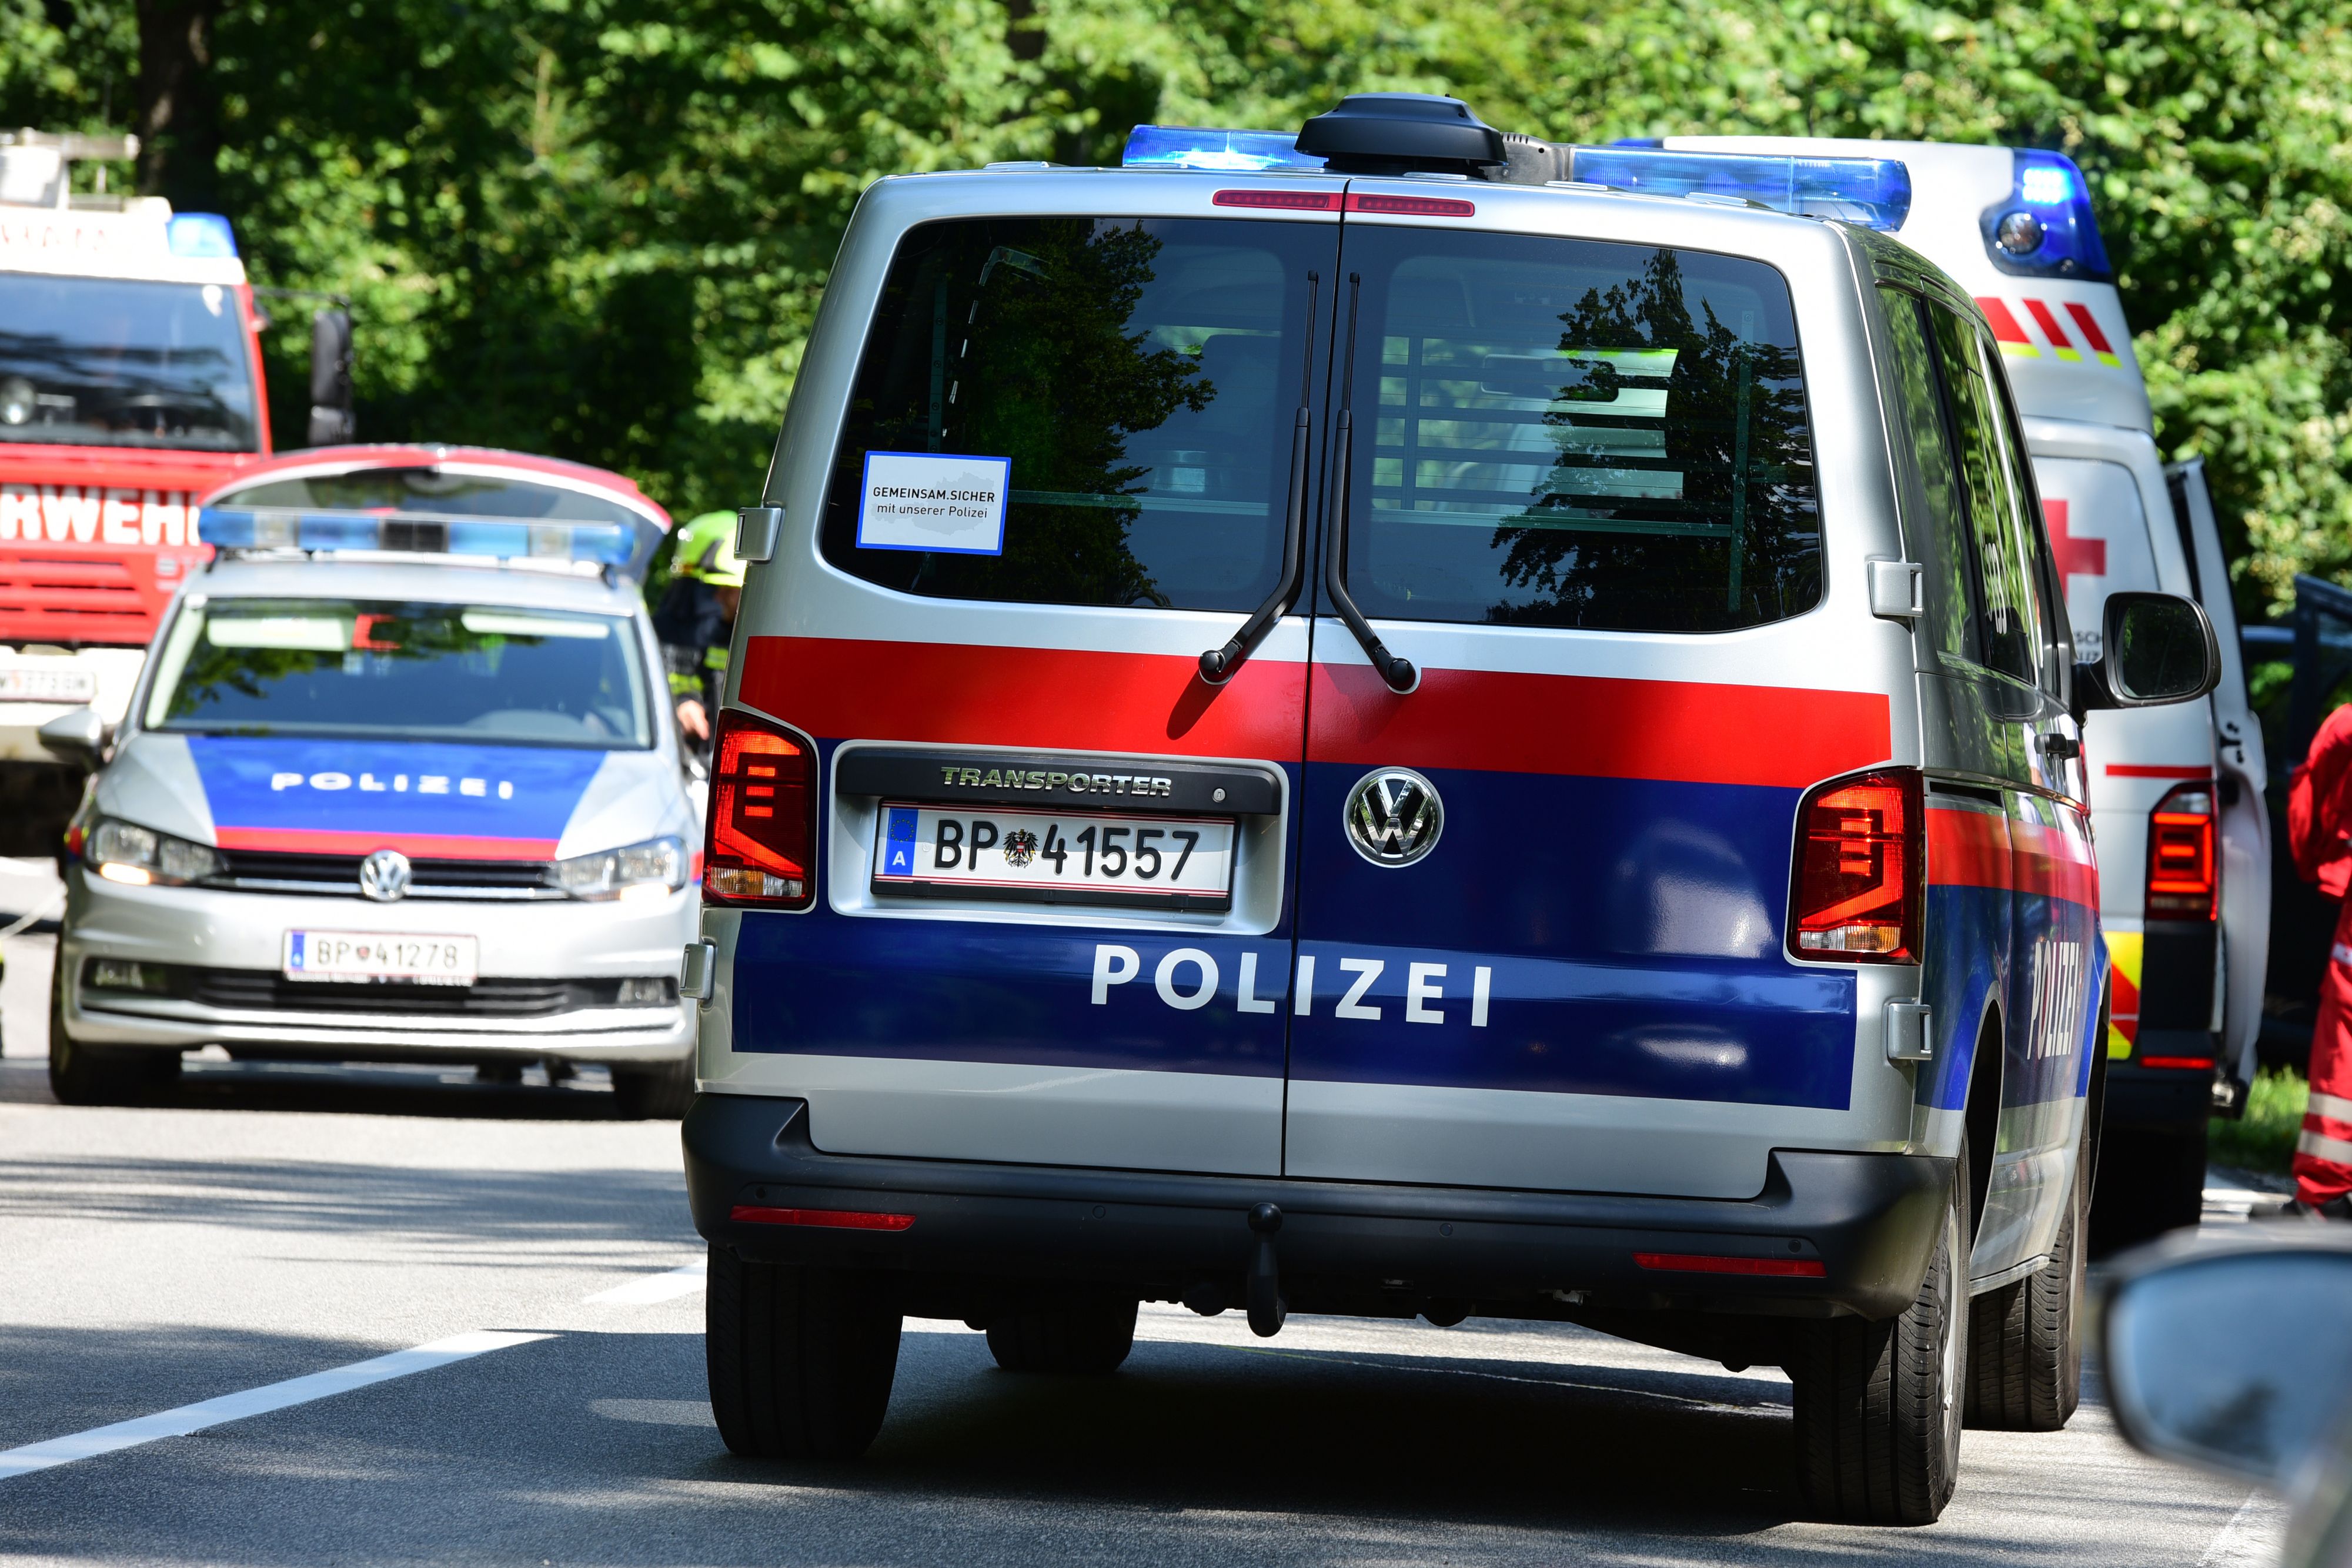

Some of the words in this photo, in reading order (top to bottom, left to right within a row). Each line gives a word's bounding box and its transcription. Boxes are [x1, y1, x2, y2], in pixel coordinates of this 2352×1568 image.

[873, 486, 995, 503] GEMEINSAM.SICHER
[877, 504, 896, 513] mit
[899, 505, 945, 516] unserer
[948, 506, 987, 518] Polizei
[271, 772, 513, 800] POLIZEI
[941, 767, 1172, 797] TRANSPORTER
[892, 851, 906, 866] A
[934, 819, 998, 871] BP
[1041, 824, 1200, 881] 41557
[318, 941, 350, 964] BP
[376, 942, 457, 969] 41278
[1091, 944, 1491, 1027] POLIZEI
[2027, 940, 2079, 1060] POLIZEI
